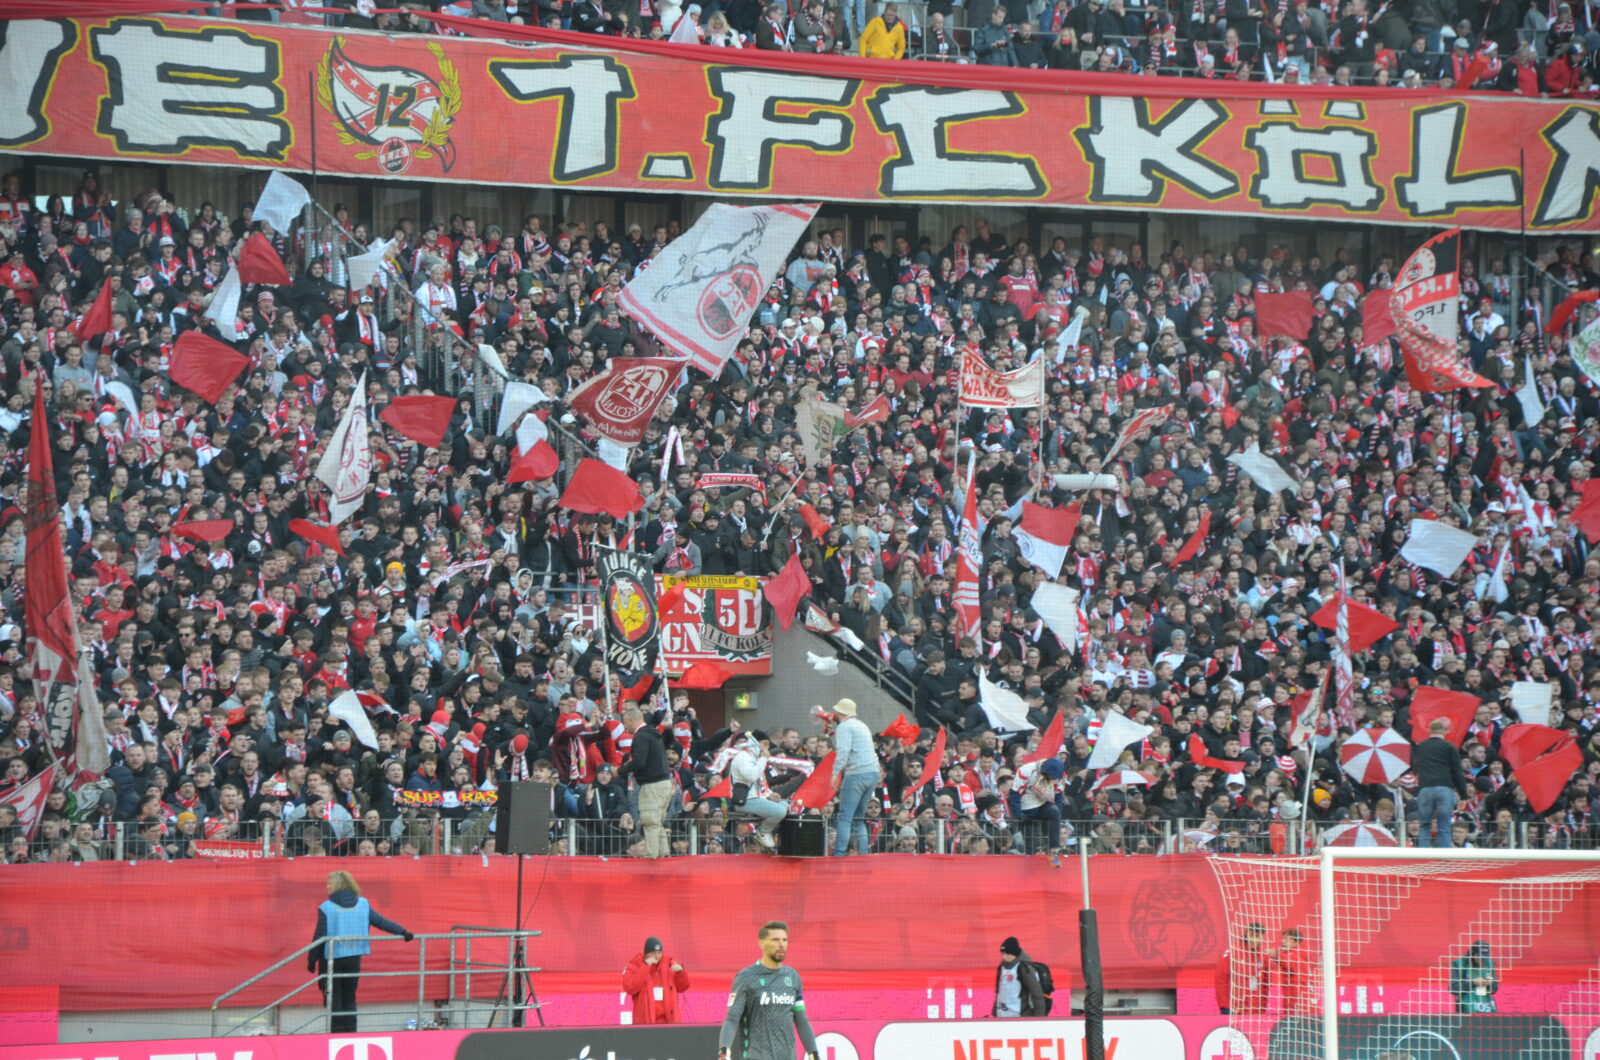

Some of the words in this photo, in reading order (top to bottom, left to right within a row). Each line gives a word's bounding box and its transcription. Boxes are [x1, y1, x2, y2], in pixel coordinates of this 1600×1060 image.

[374, 82, 418, 129] 12
[772, 992, 795, 1005] heise
[953, 1037, 1119, 1060] NETFL
